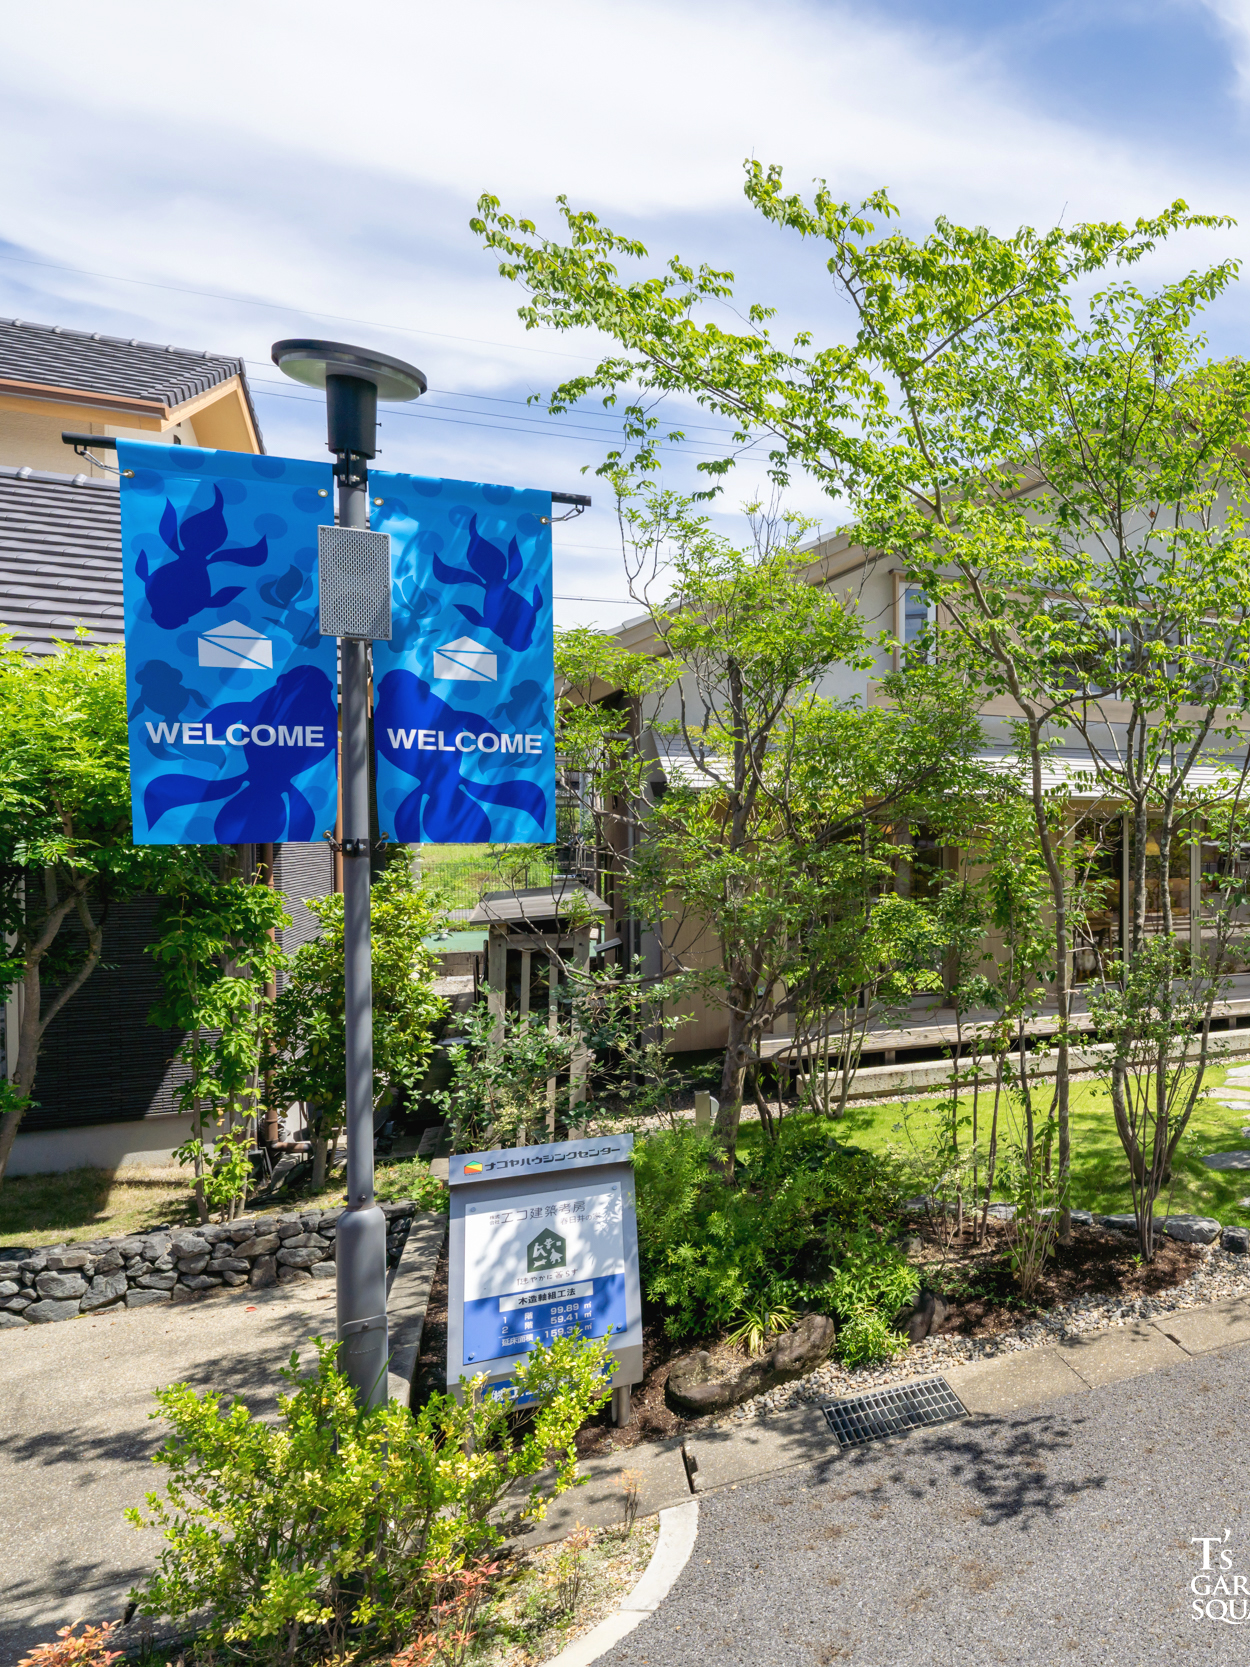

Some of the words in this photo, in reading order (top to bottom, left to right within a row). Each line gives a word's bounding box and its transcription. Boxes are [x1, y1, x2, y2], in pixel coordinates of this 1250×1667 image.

[145, 721, 325, 747] WELCOME
[387, 728, 543, 754] WELCOME
[518, 1287, 577, 1305] 木造軸組工法
[502, 1316, 508, 1324] 1
[524, 1312, 534, 1321] 階
[550, 1303, 580, 1315] 99.89
[502, 1326, 509, 1334] 2
[524, 1321, 534, 1330] 階
[550, 1312, 579, 1325] 59.41
